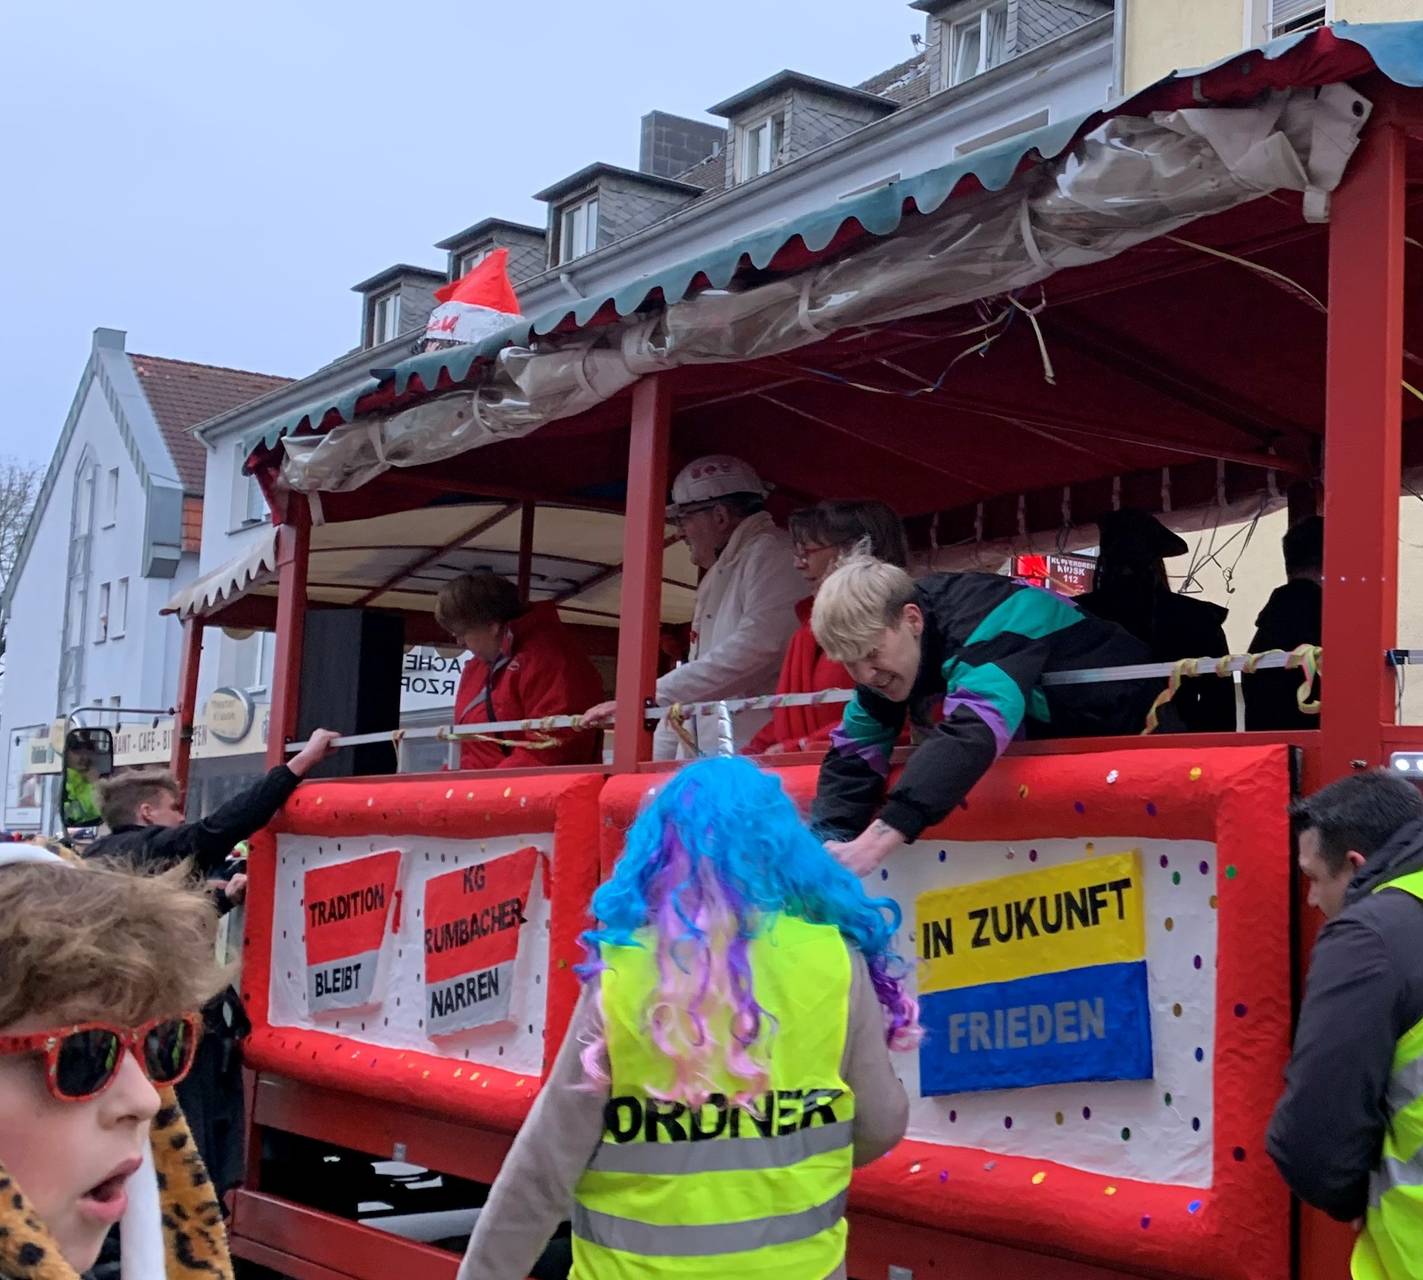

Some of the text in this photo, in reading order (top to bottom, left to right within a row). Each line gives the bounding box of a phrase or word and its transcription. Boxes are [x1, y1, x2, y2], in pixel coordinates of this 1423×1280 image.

[1057, 565, 1085, 576] KIOSK
[1063, 574, 1079, 584] 112
[463, 864, 486, 894] KG
[308, 883, 385, 928] TRADITION
[424, 898, 528, 954] RUMBACHER
[923, 878, 1132, 960] IN ZUKUNFT
[315, 963, 361, 998] BLEIBT
[431, 968, 499, 1018] NARREN
[949, 997, 1106, 1054] FRIEDEN
[603, 1089, 845, 1143] ORDNER
